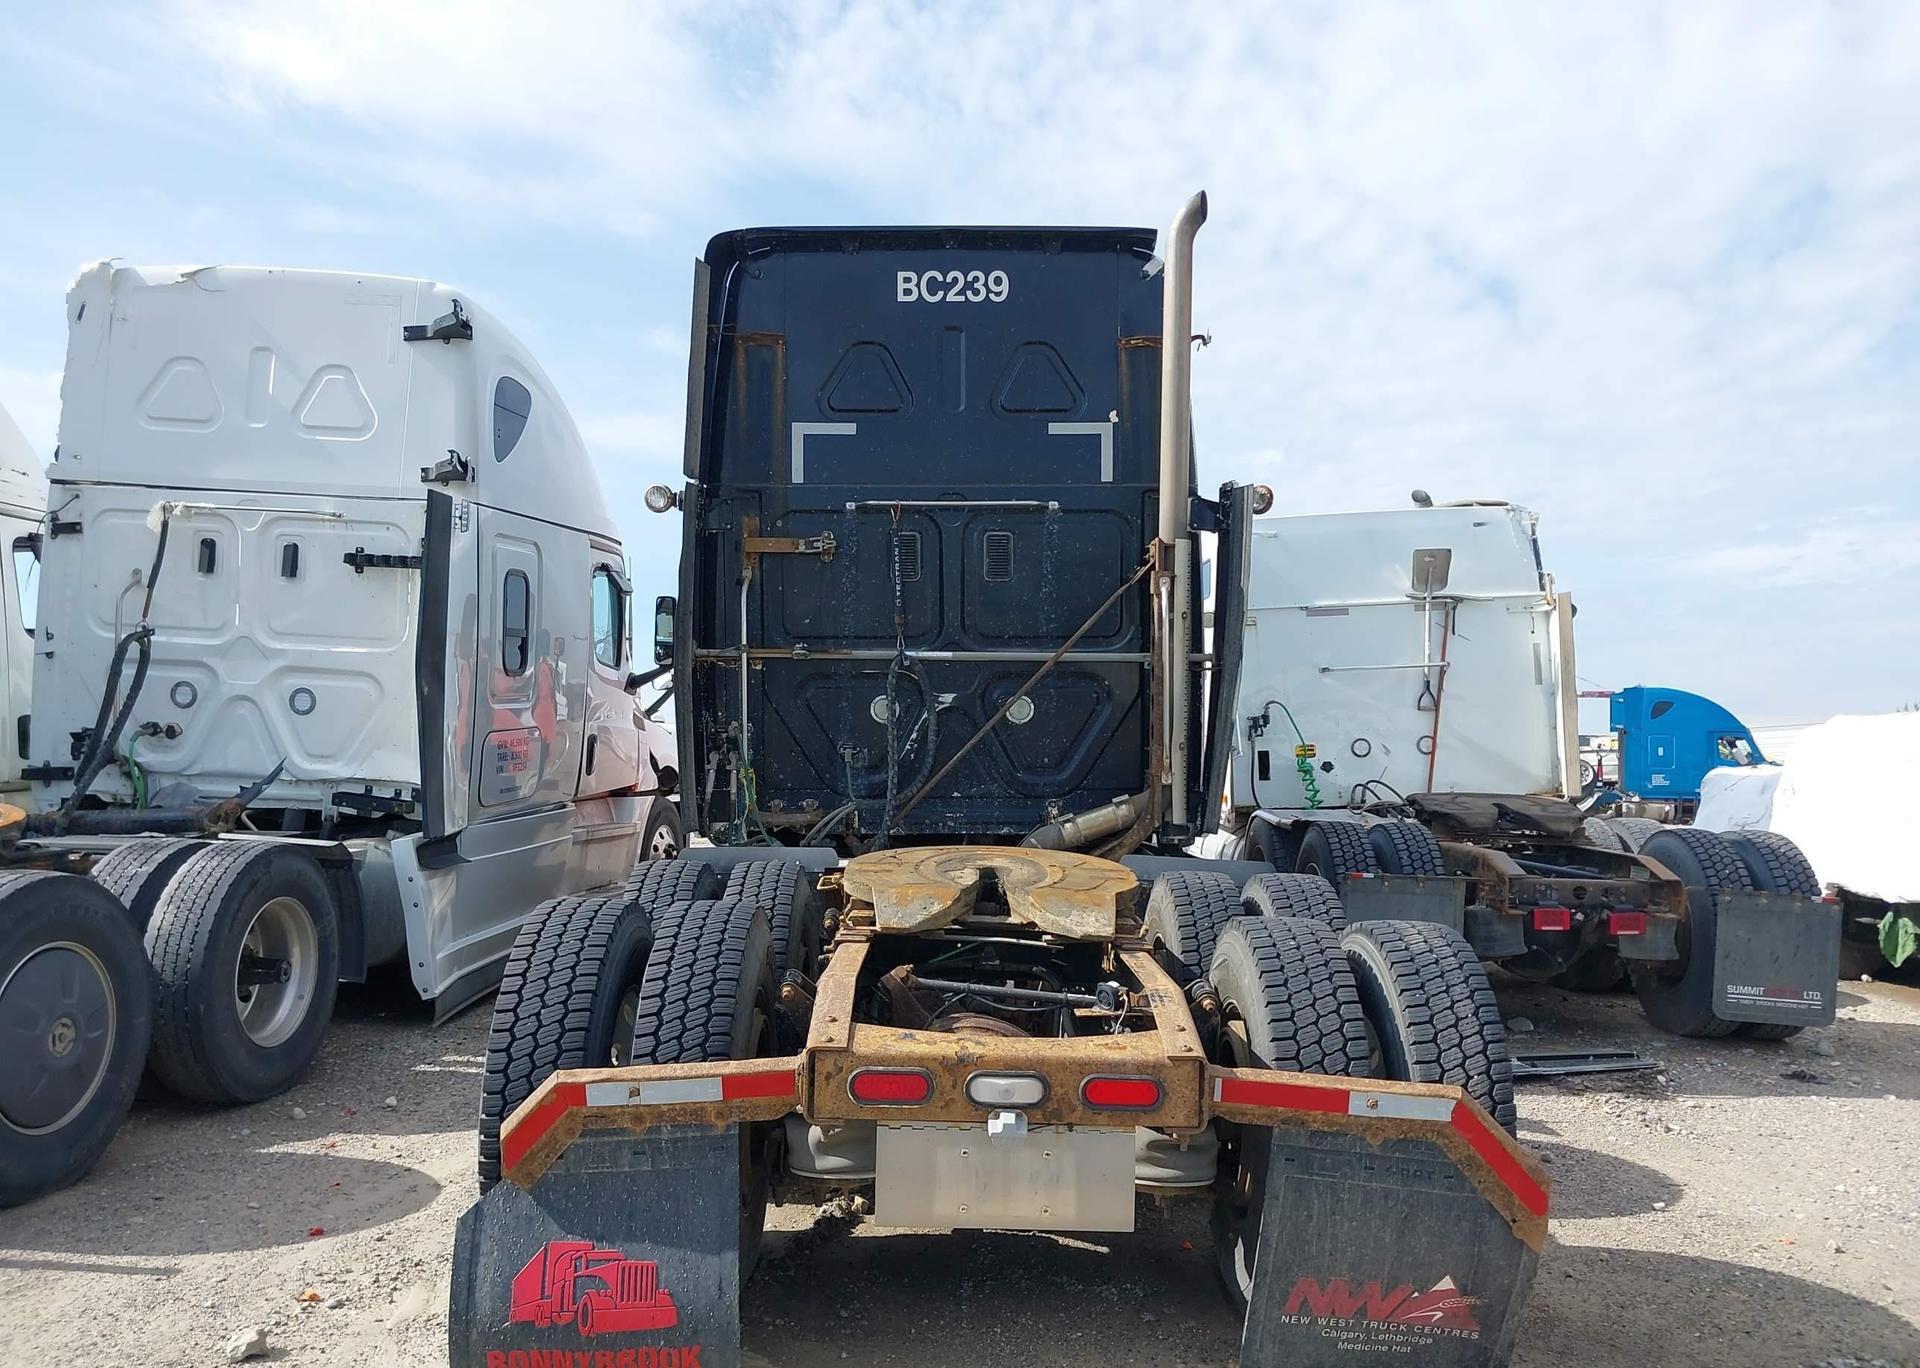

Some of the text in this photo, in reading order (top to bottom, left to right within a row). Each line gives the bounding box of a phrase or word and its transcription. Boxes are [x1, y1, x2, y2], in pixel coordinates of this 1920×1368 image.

[897, 270, 1010, 303] BC239
[1727, 984, 1765, 996] SUMMIT
[1803, 991, 1822, 1000] LTD.
[1281, 1315, 1480, 1340] NEW WEST TRUCK CENTRES
[1321, 1328, 1433, 1345] Calgary, Lethbridge
[486, 1345, 701, 1368] BONNYBROOK
[1337, 1341, 1411, 1353] Medicine Hat
